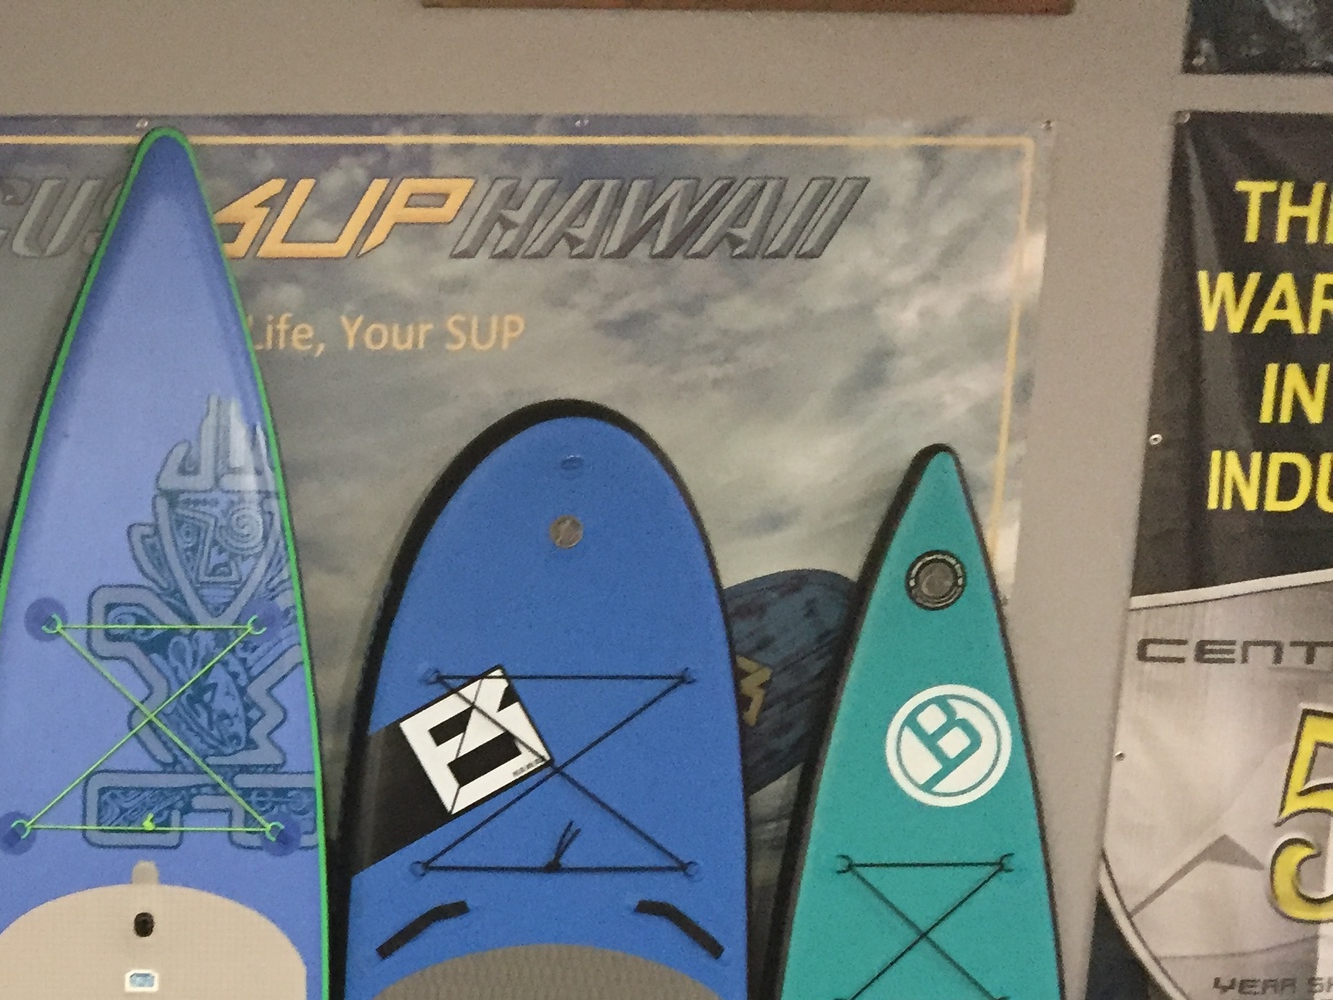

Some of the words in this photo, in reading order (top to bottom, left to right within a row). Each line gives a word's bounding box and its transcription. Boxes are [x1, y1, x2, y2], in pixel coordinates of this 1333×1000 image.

[213, 177, 475, 258] SUP
[450, 176, 871, 259] HAWAII
[1235, 179, 1333, 244] TH
[340, 314, 434, 351] Your
[444, 313, 526, 351] SUP
[1258, 362, 1331, 425] IN
[1136, 638, 1333, 665] CENT
[1213, 976, 1297, 995] YEAR
